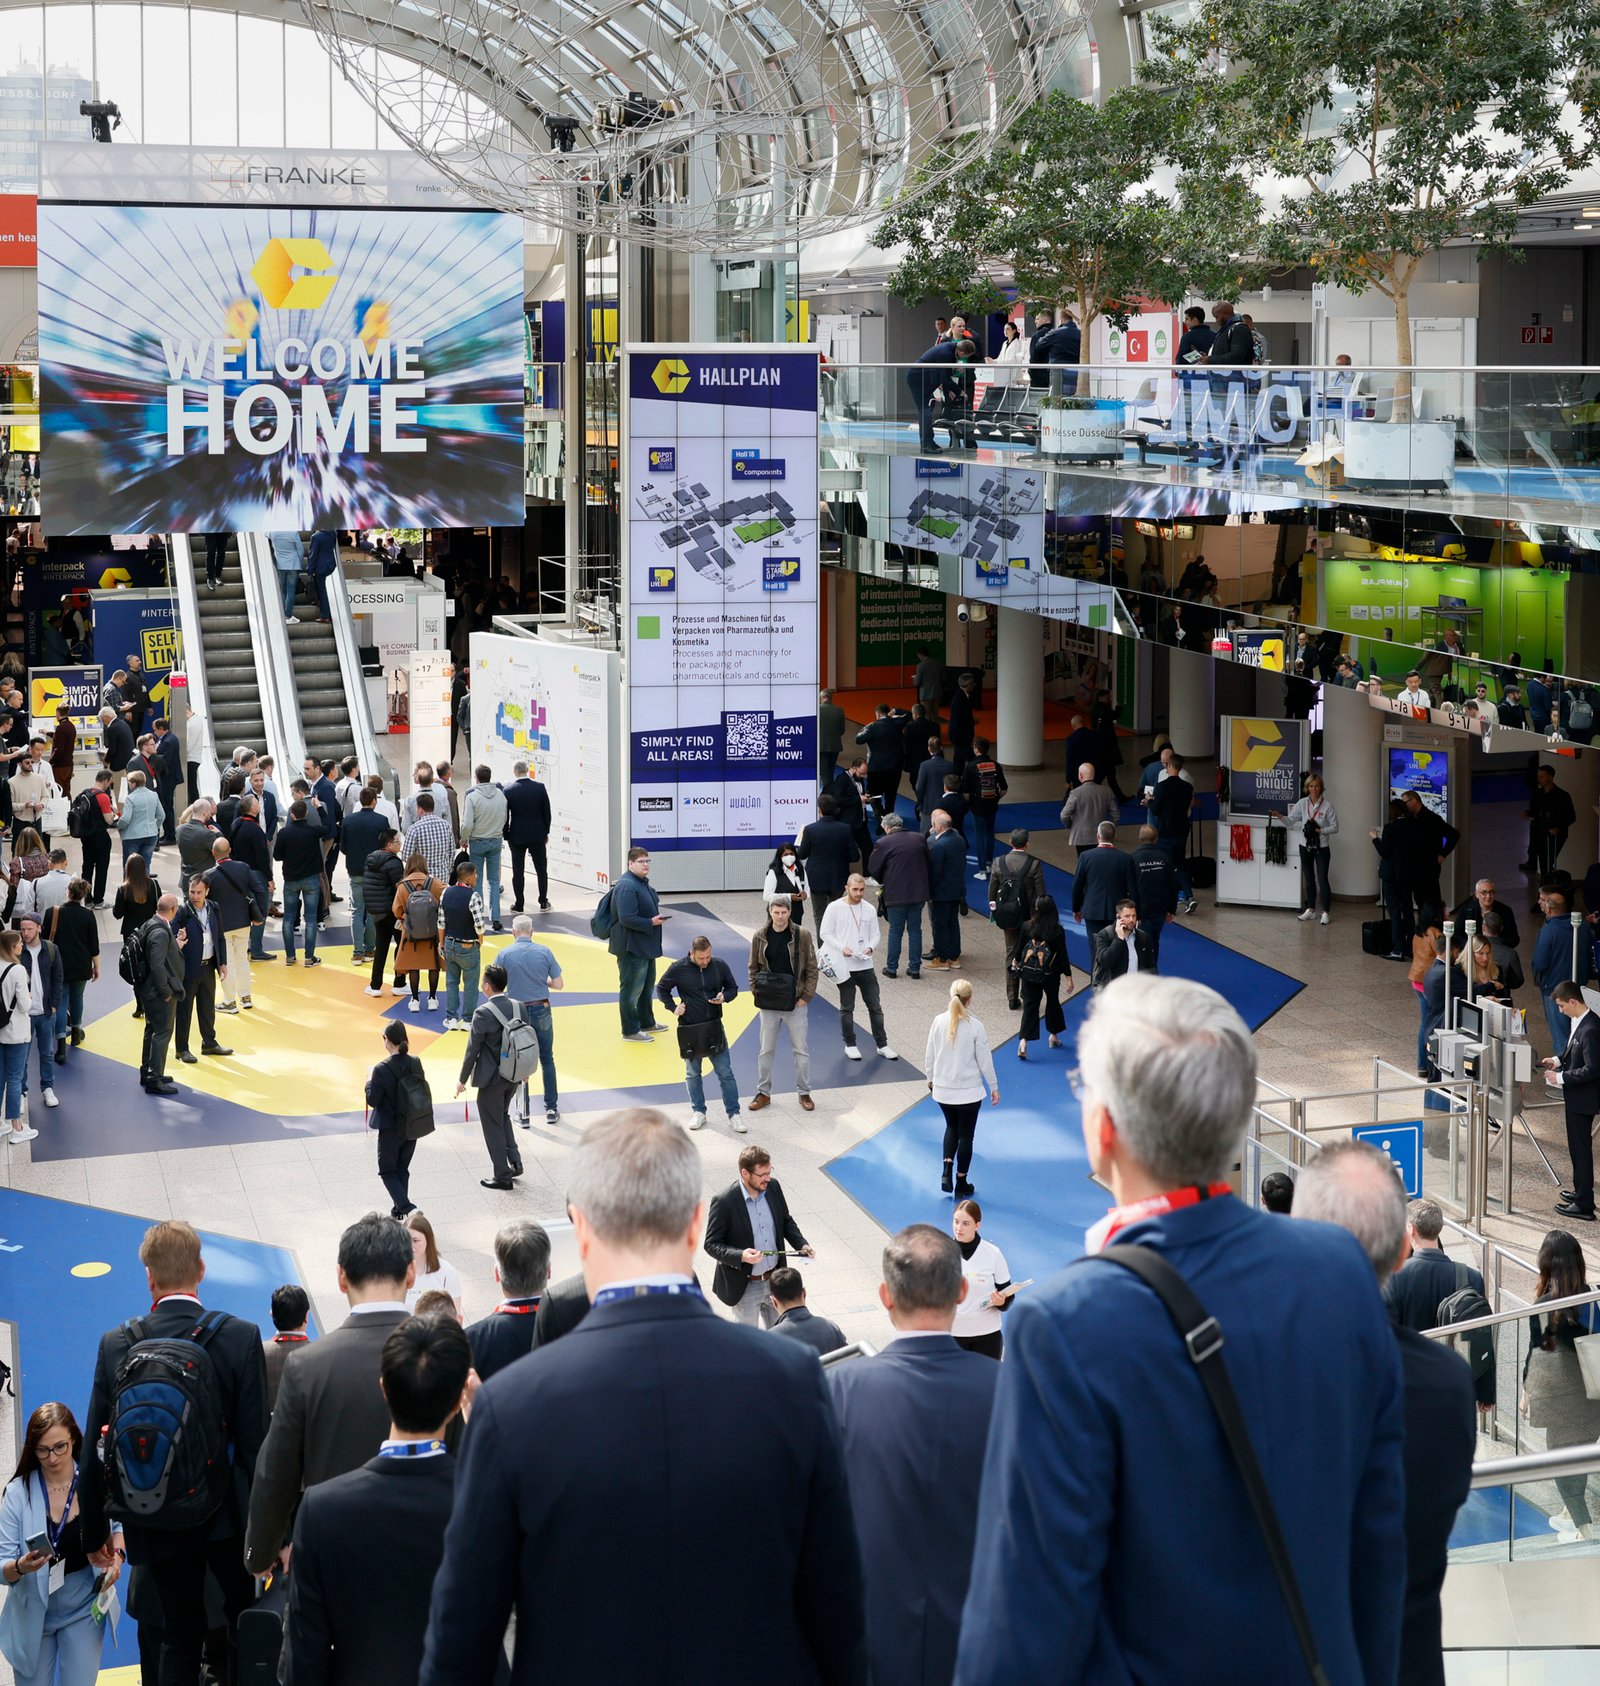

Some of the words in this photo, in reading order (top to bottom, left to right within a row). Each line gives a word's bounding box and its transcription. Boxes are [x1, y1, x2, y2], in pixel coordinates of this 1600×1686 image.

[248, 166, 366, 185] FRANKE
[0, 234, 15, 242] en
[161, 337, 424, 380] WELCOME
[700, 367, 780, 386] HALLPLAN
[166, 383, 427, 456] HOME
[1052, 427, 1077, 437] Messe
[42, 561, 85, 572] interpack
[860, 575, 874, 586] The
[861, 589, 869, 600] of
[869, 588, 921, 600] internatonal
[860, 603, 896, 614] business
[896, 601, 943, 614] intelligence
[672, 615, 705, 623] Prozesse
[706, 615, 720, 623] und
[721, 614, 759, 623] Maschinen
[760, 614, 772, 622] für
[773, 614, 786, 622] das
[860, 617, 900, 628] dedicated
[672, 627, 711, 636] Verpacken
[726, 625, 780, 634] Pharmazeutika
[781, 625, 794, 634] und
[672, 638, 709, 646] Kosmetika
[860, 632, 869, 642] to
[869, 631, 900, 644] plastics
[904, 630, 944, 643] packaging
[672, 649, 714, 658] Processes
[716, 649, 733, 657] and
[735, 648, 779, 658] machinery
[781, 647, 792, 657] for
[422, 665, 432, 673] 17
[672, 661, 687, 669] the
[689, 660, 732, 670] packaging
[733, 660, 742, 668] of
[672, 671, 742, 681] pharmaceuticals
[744, 671, 760, 679] and
[762, 670, 800, 679] cosmetic
[62, 685, 98, 695] SIMPLY
[62, 693, 98, 708] ENJOY
[776, 725, 803, 735] SCAN
[640, 736, 683, 747] SIMPLY
[686, 735, 714, 747] FIND
[776, 738, 791, 748] ME
[646, 751, 669, 762] ALL
[671, 750, 713, 761] AREAS!
[776, 750, 803, 761] NOW!
[1256, 768, 1294, 779] SIMPLY
[1256, 777, 1294, 790] UNIQUE
[692, 797, 719, 805] KOCH
